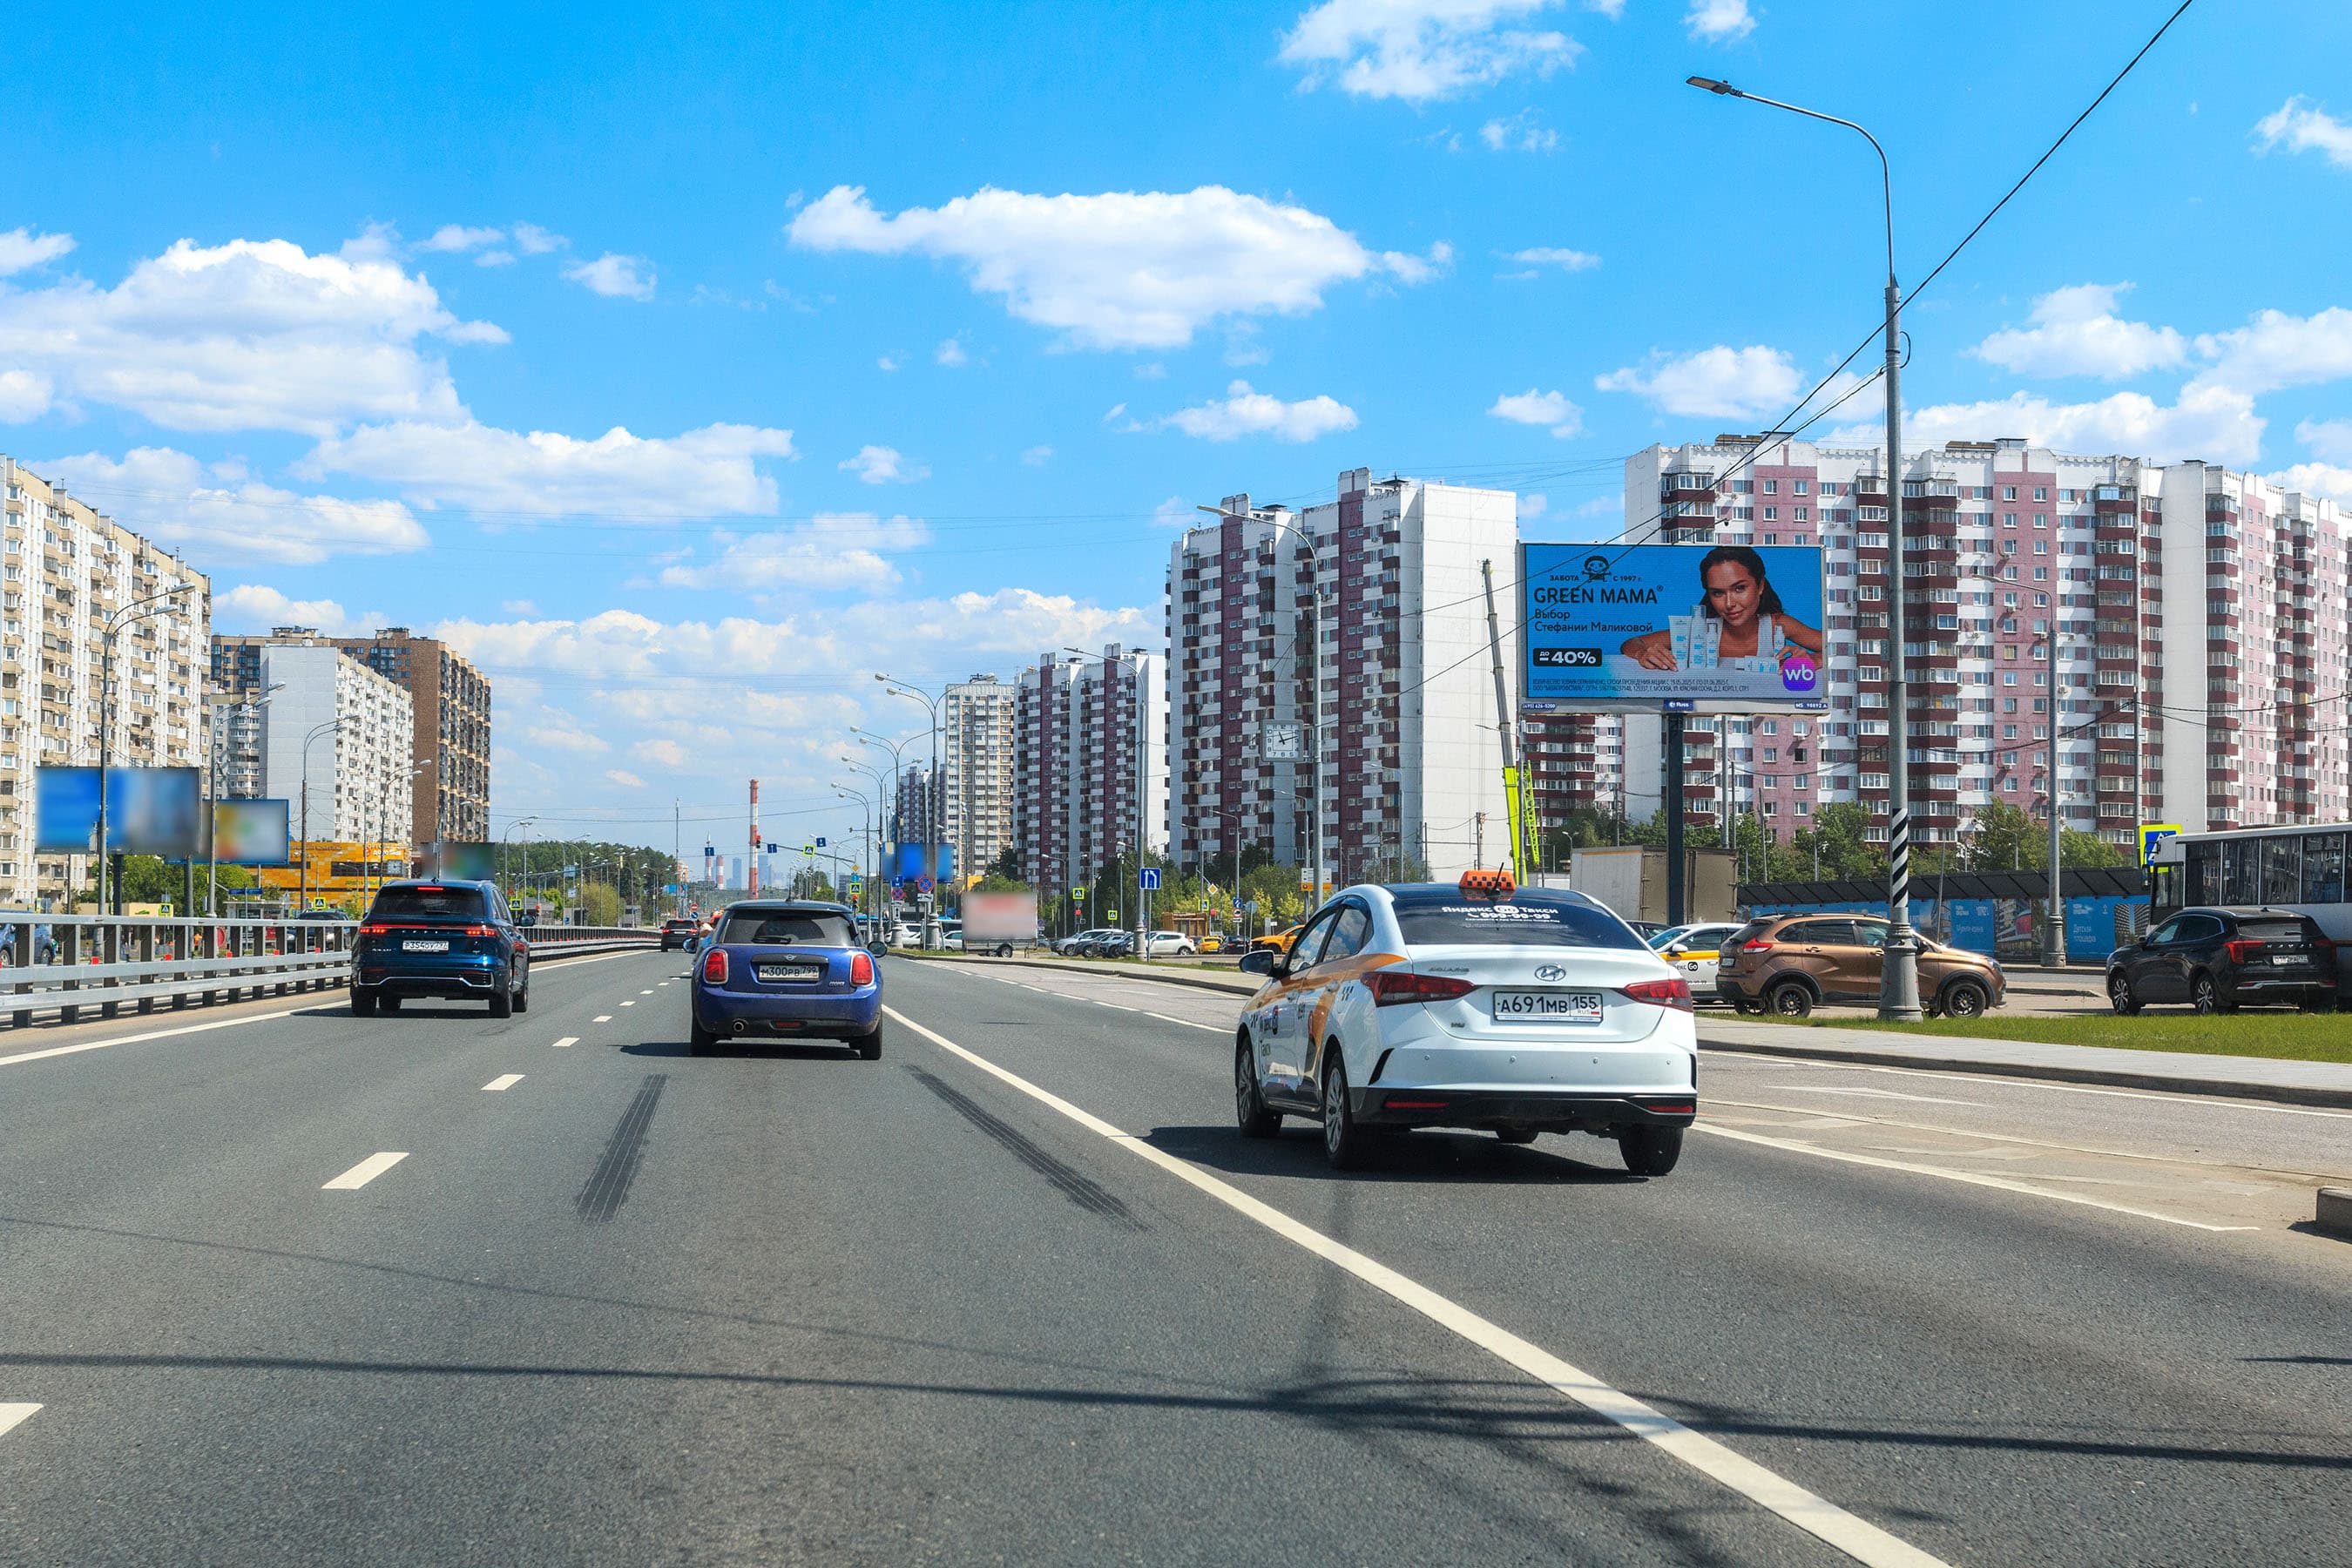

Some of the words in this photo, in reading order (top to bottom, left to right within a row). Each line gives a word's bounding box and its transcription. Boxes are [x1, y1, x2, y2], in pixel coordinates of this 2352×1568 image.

[1534, 587, 1593, 603] GREEN
[1535, 609, 1571, 620] Выбор
[1535, 622, 1588, 632] Стефании
[1592, 622, 1652, 632] Маликовой
[1785, 664, 1813, 681] wb
[1500, 996, 1568, 1013] А691МВ
[1571, 996, 1598, 1010] 155
